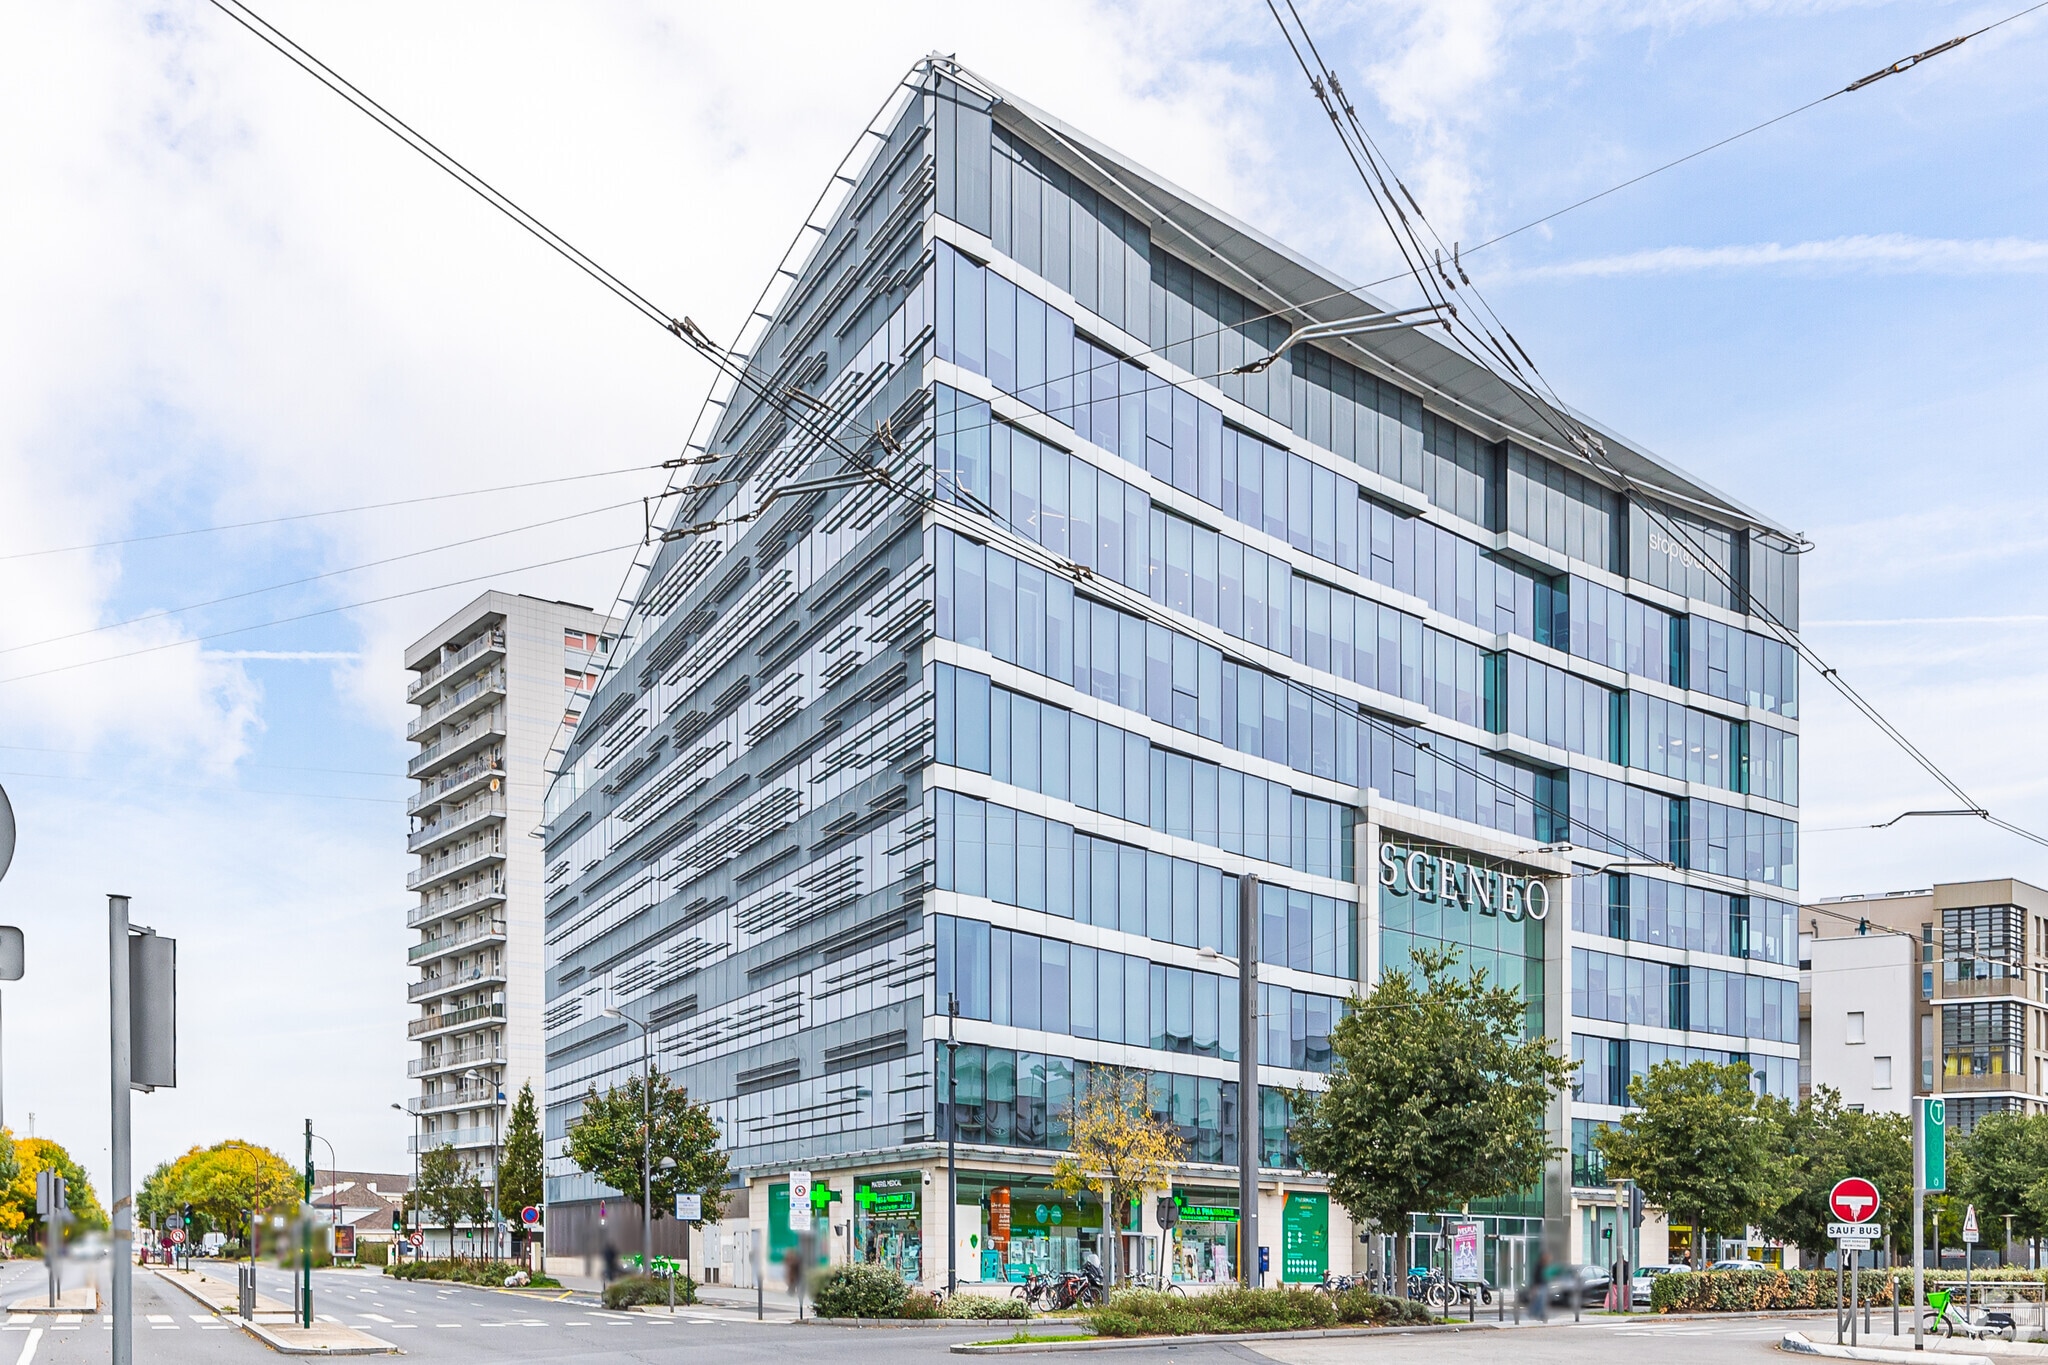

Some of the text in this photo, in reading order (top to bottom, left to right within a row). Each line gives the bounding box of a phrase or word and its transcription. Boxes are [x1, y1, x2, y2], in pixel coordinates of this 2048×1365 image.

[1379, 841, 1550, 921] SCENEO
[1829, 1226, 1879, 1235] SAUF BUS
